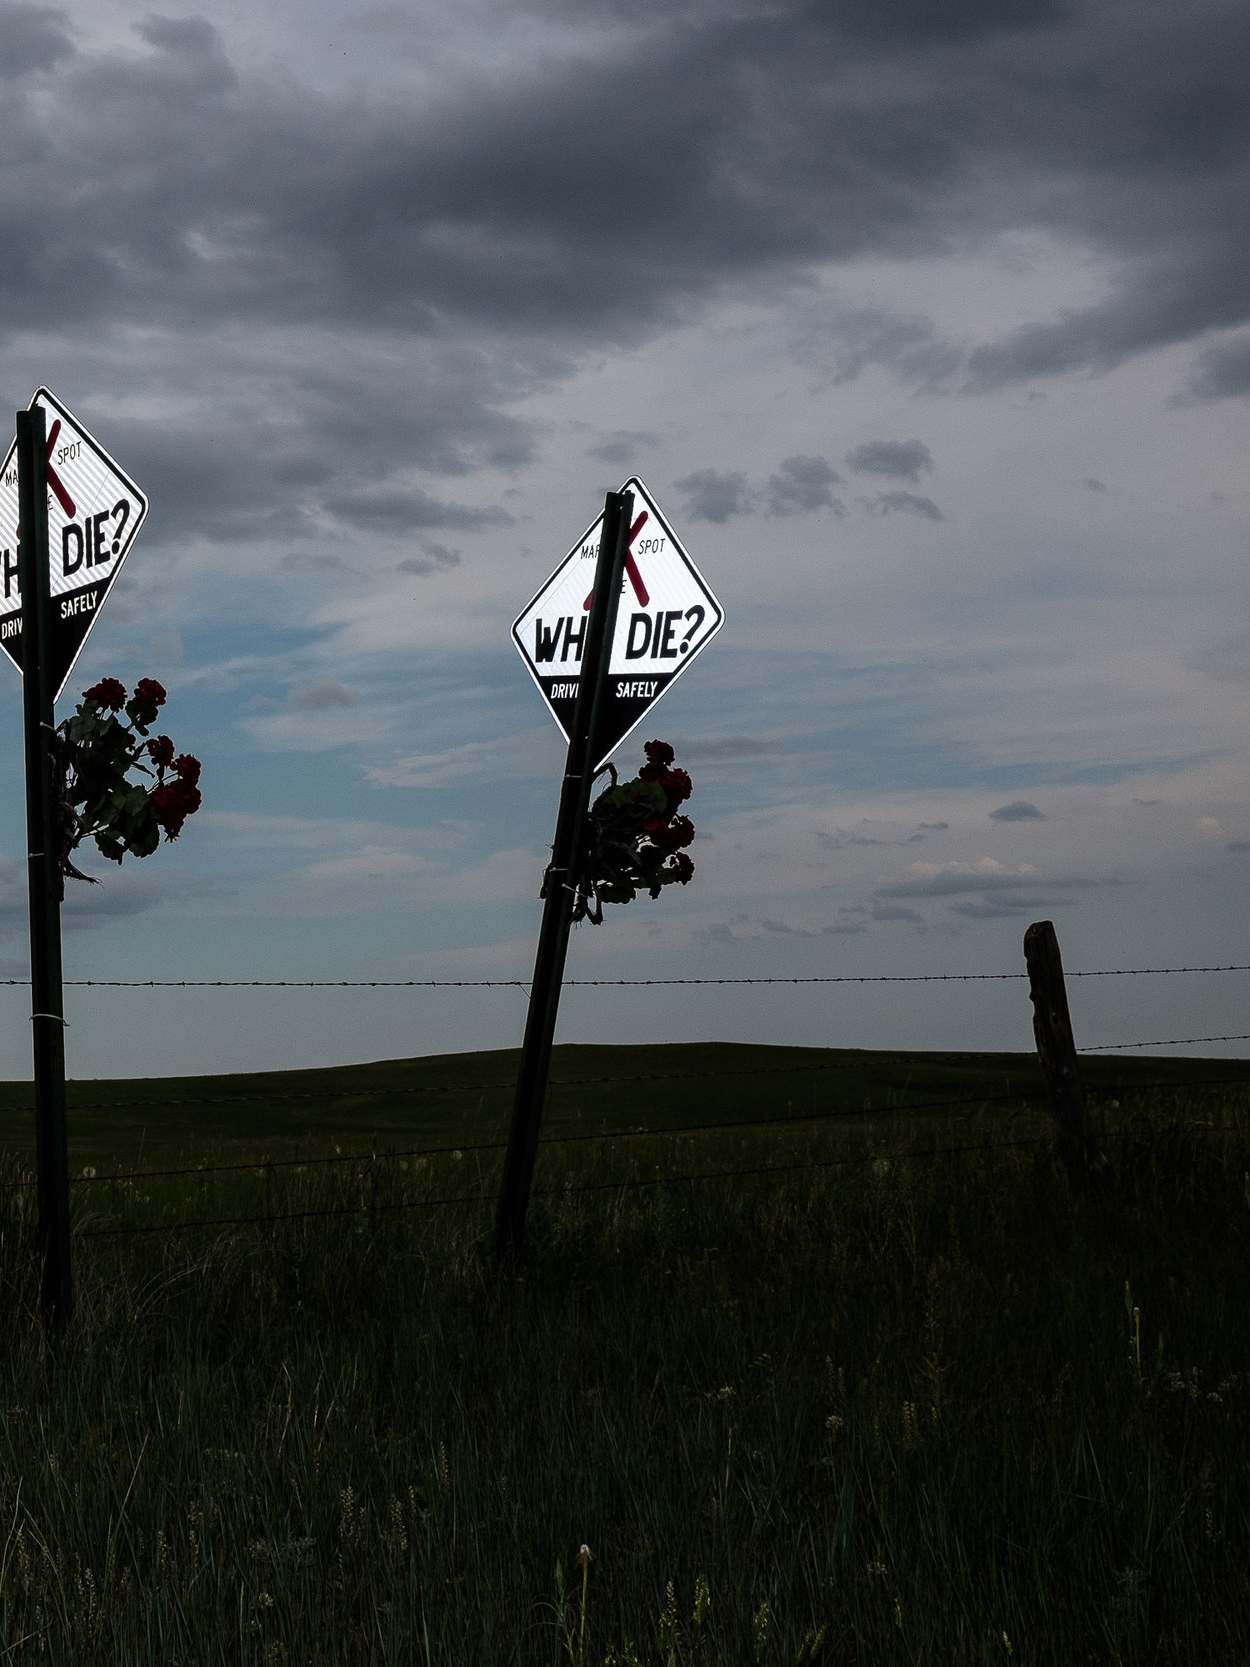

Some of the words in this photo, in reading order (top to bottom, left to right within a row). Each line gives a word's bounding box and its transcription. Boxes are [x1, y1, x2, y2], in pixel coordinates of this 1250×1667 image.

[57, 441, 82, 465] SPOT
[62, 499, 130, 577] DIE?
[580, 544, 600, 559] MAR
[638, 538, 665, 556] SPOT
[1, 618, 23, 639] DRIV
[60, 591, 98, 619] SAFELY
[535, 616, 588, 663] WH
[625, 605, 705, 660] DIE?
[616, 681, 658, 698] SAFELY
